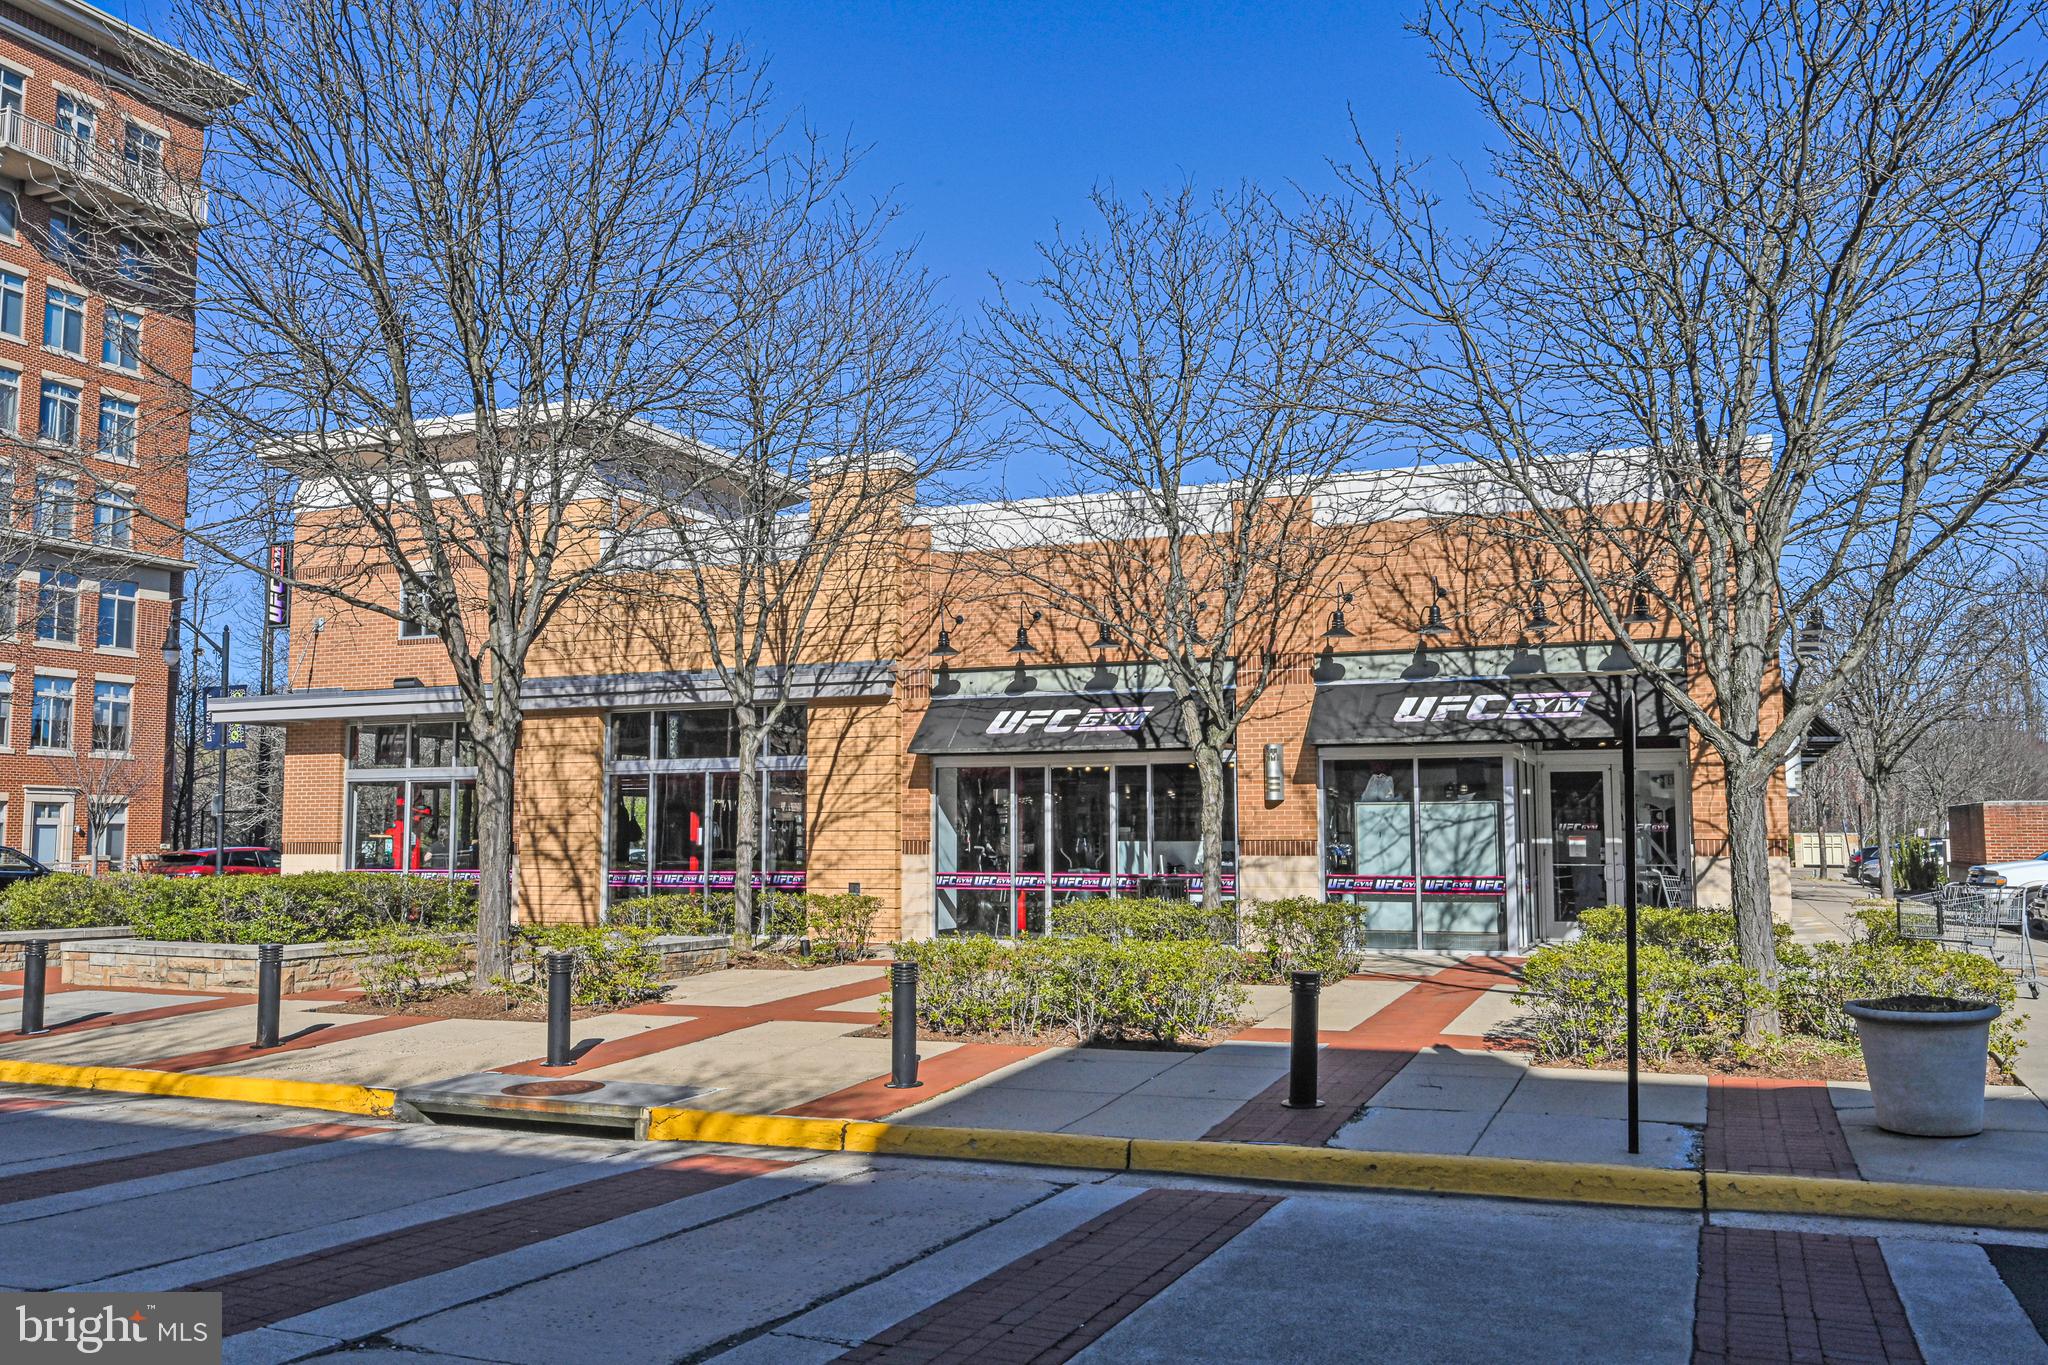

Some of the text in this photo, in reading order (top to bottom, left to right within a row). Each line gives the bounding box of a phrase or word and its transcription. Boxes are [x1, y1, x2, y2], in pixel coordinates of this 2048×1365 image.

[269, 577, 285, 623] UFC
[1393, 694, 1589, 722] UFC GYM
[986, 709, 1151, 734] UFC GYM
[628, 874, 647, 884] UFC
[664, 874, 683, 884] UFC
[773, 874, 793, 884] UFC
[936, 876, 956, 885] UFC
[974, 876, 997, 886] UFC
[1016, 876, 1038, 886] UFC
[1059, 878, 1082, 887] UFC
[1328, 878, 1354, 888] UFC
[1354, 880, 1372, 888] GYM
[1376, 880, 1403, 890] UFC
[1424, 880, 1452, 890] UFC
[1474, 880, 1503, 890] UFC
